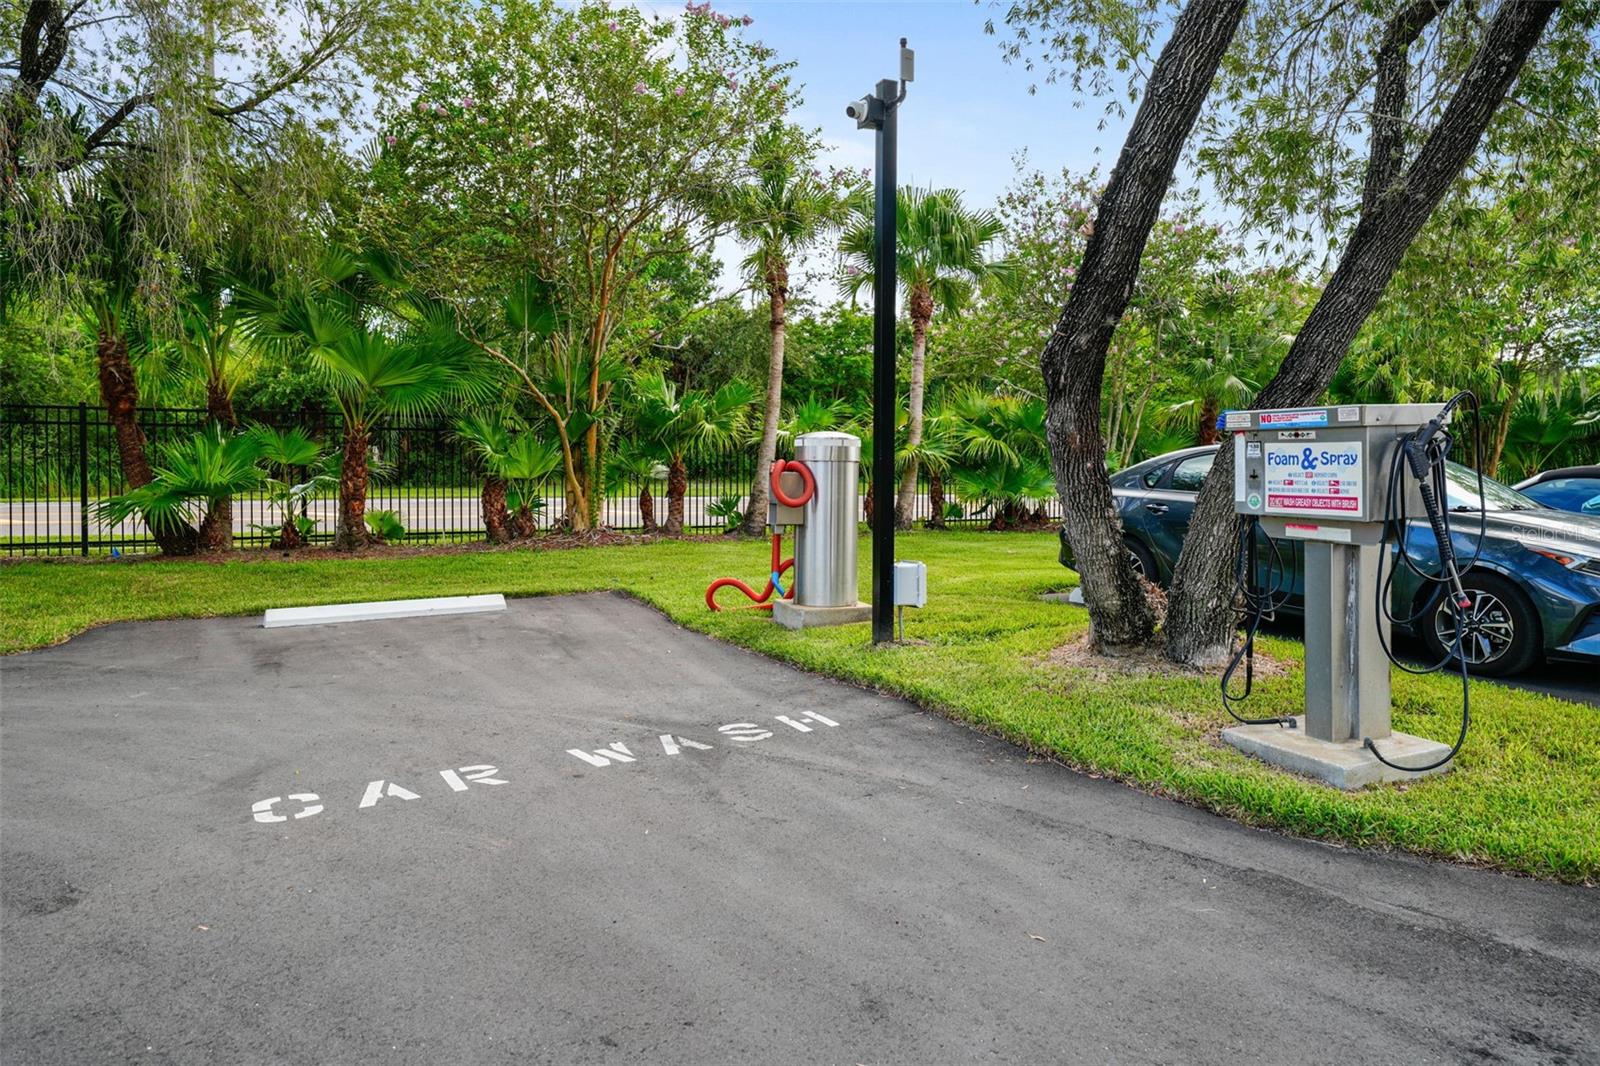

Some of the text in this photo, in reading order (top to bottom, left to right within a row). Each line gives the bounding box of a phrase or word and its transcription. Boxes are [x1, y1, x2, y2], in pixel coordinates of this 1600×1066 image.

[1260, 414, 1272, 423] NO
[1268, 452, 1299, 466] Foam
[1301, 447, 1318, 470] &
[1320, 451, 1358, 466] Spray
[1312, 498, 1331, 508] OBJECTS
[1331, 499, 1342, 508] WITH
[252, 710, 840, 823] CAR WASH
